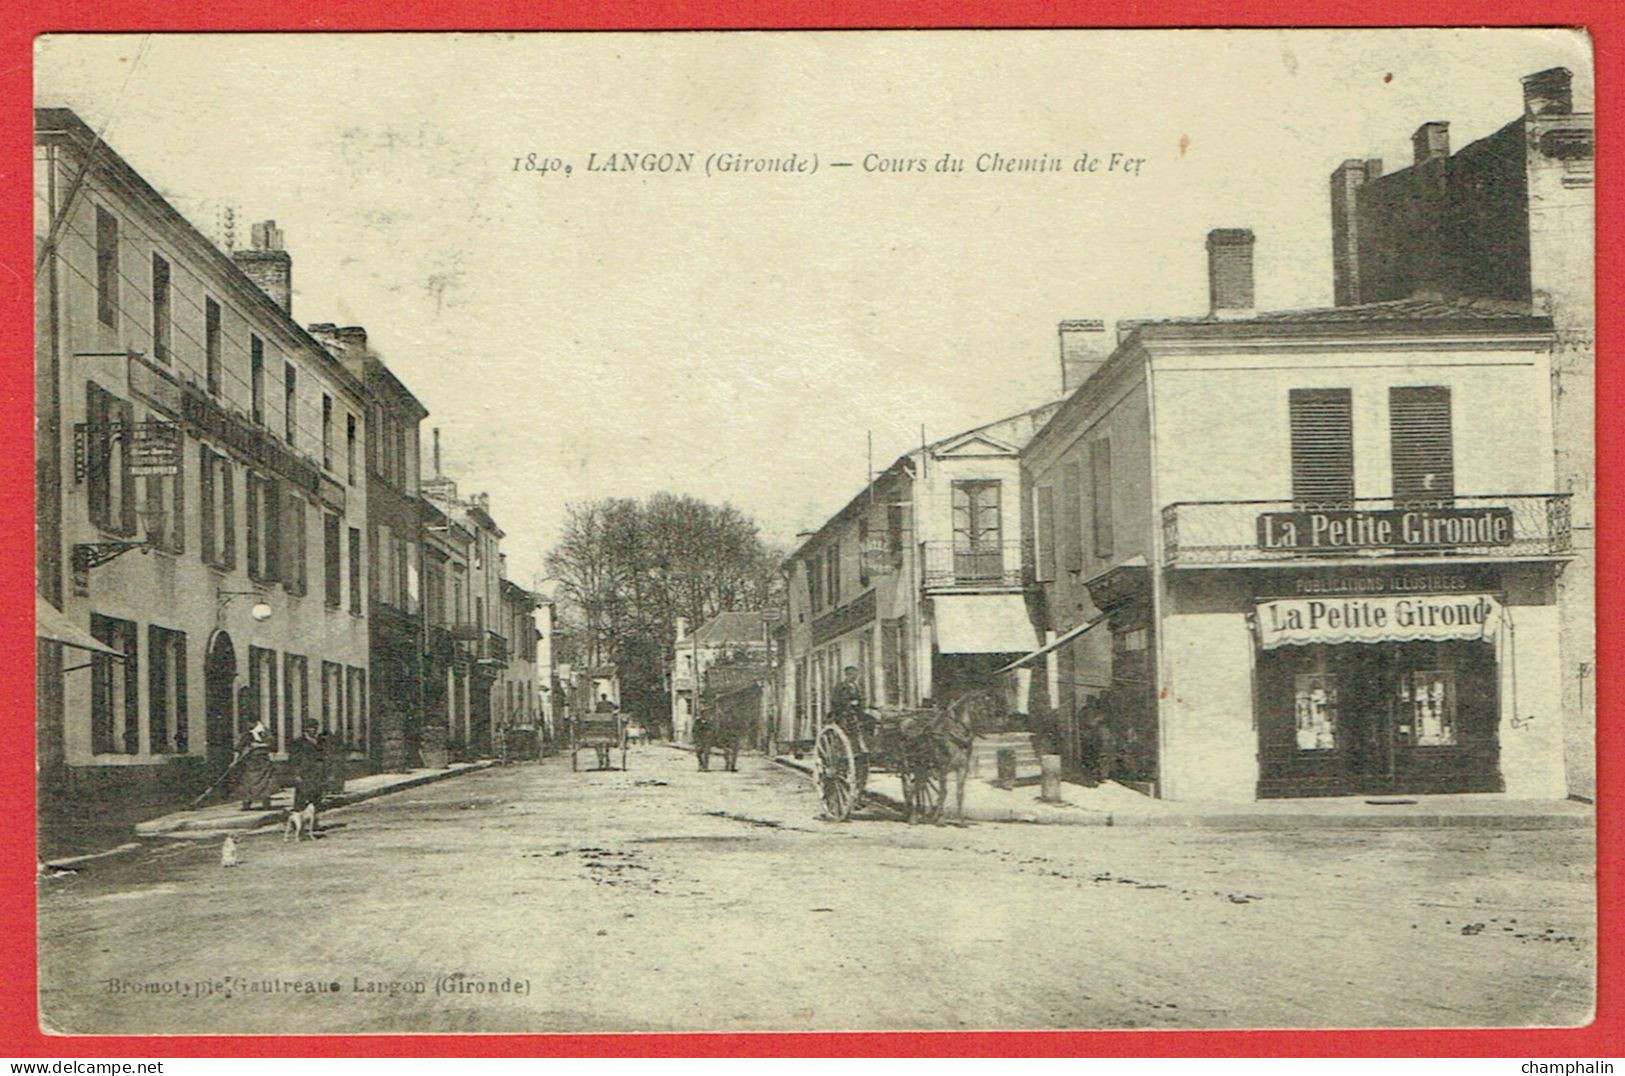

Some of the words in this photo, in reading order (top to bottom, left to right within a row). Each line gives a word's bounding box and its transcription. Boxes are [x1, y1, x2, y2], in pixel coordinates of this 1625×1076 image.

[1264, 514, 1298, 548] La
[1311, 513, 1393, 547] Petite
[1402, 511, 1510, 545] Gironde
[1269, 604, 1303, 632] La
[1308, 601, 1388, 630] Petite
